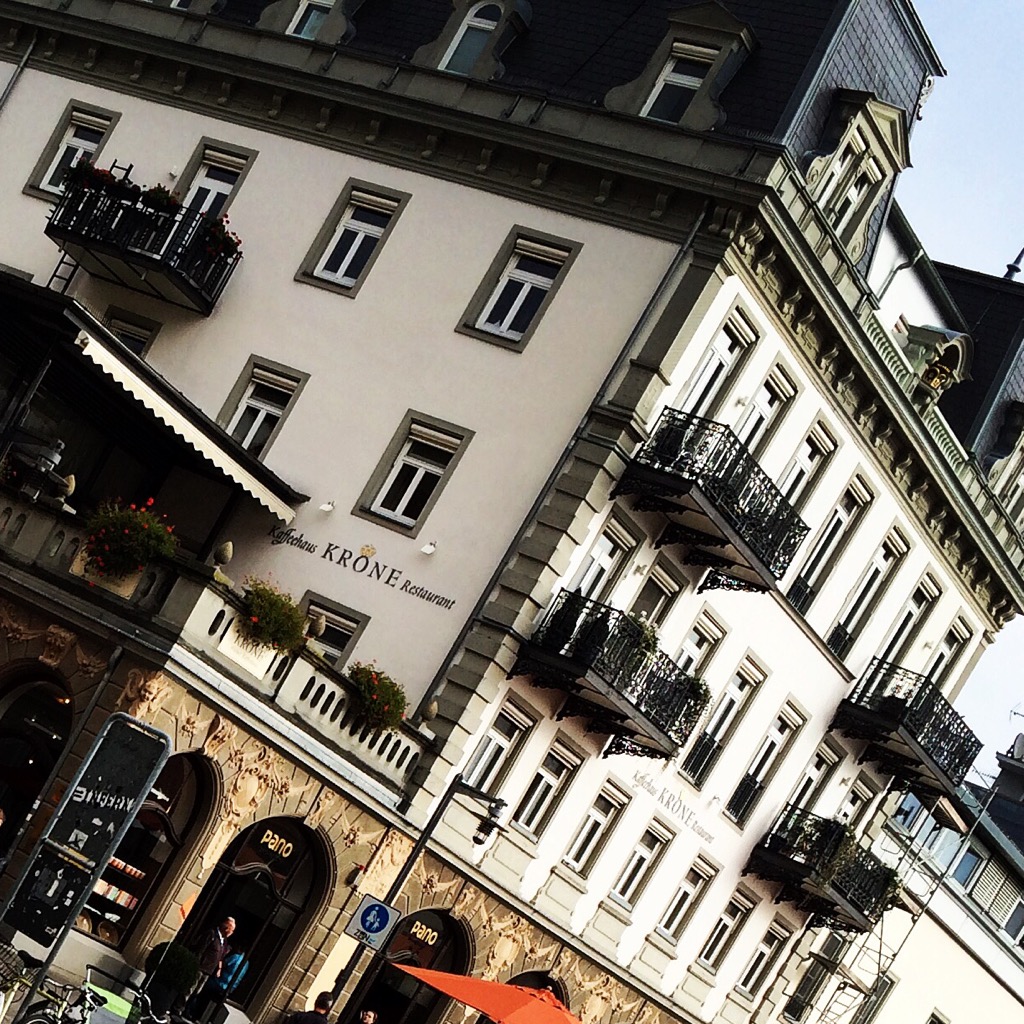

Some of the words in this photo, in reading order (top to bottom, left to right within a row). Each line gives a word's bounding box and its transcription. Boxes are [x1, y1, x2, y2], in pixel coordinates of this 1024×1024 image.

[268, 525, 318, 554] Kaffeehaus
[321, 542, 403, 588] KRONE
[399, 579, 456, 610] Restaurant
[657, 787, 696, 827] KRONE
